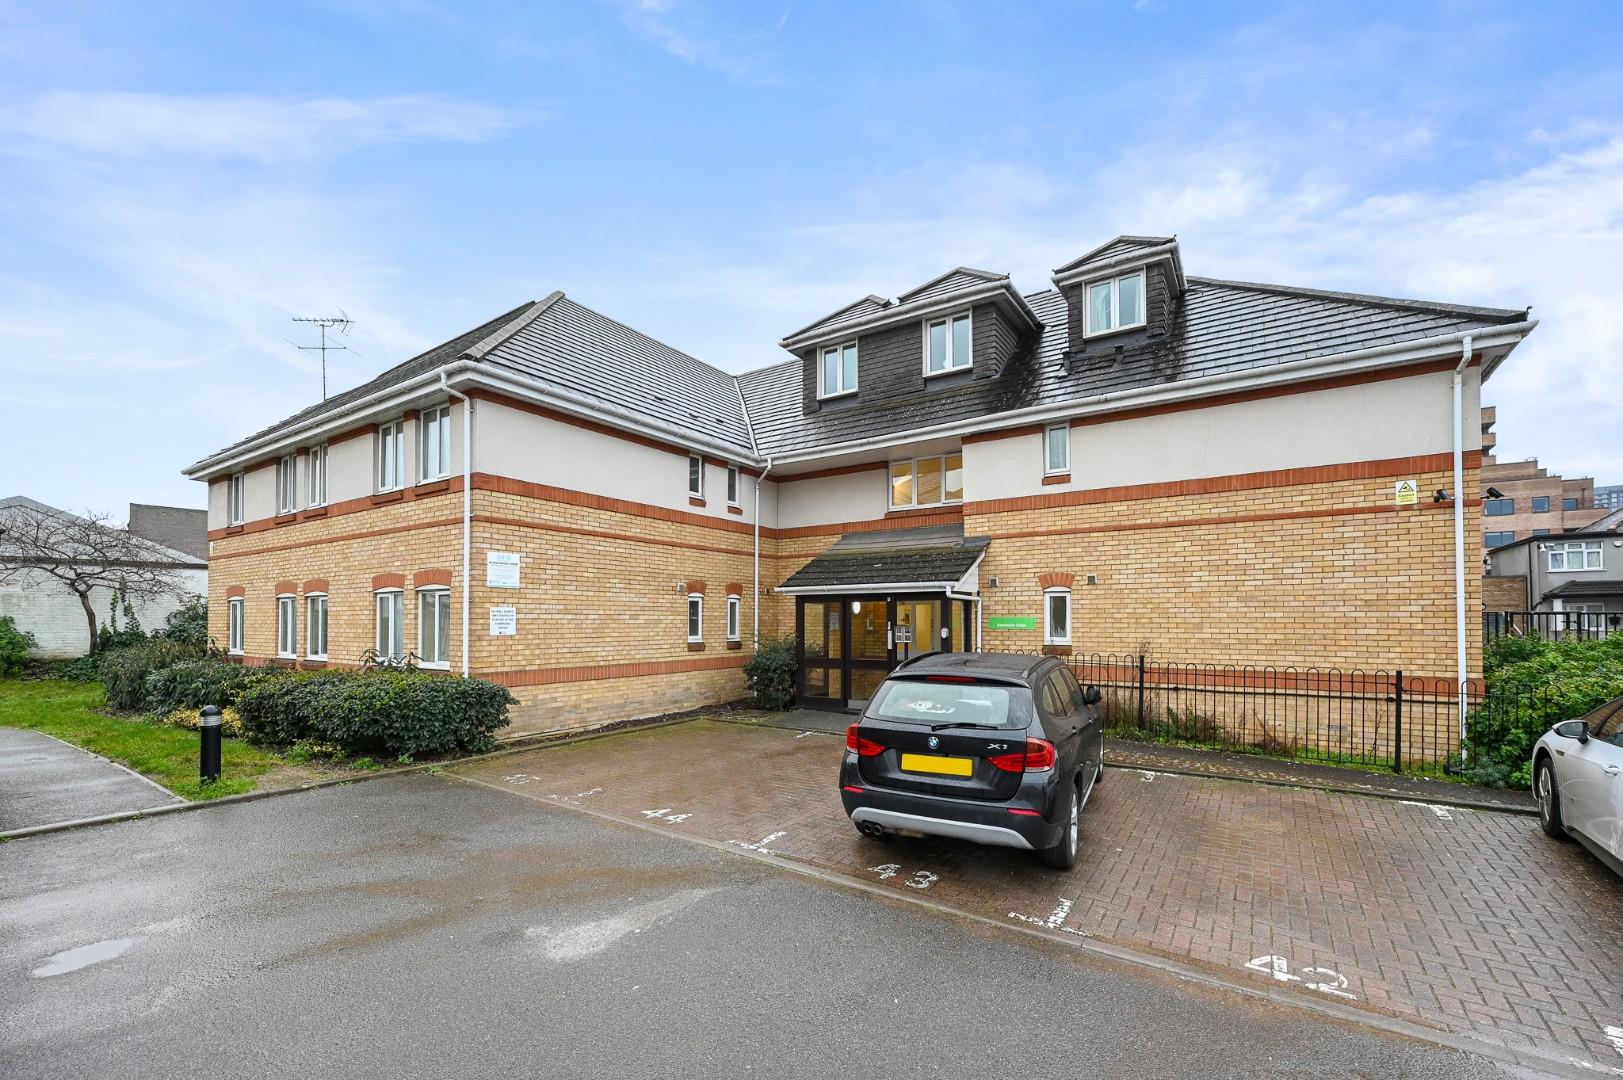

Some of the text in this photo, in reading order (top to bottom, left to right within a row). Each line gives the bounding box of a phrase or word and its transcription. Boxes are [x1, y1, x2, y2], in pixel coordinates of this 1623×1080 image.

[640, 808, 693, 824] 44
[866, 863, 938, 889] 43
[1244, 955, 1357, 1000] 42
